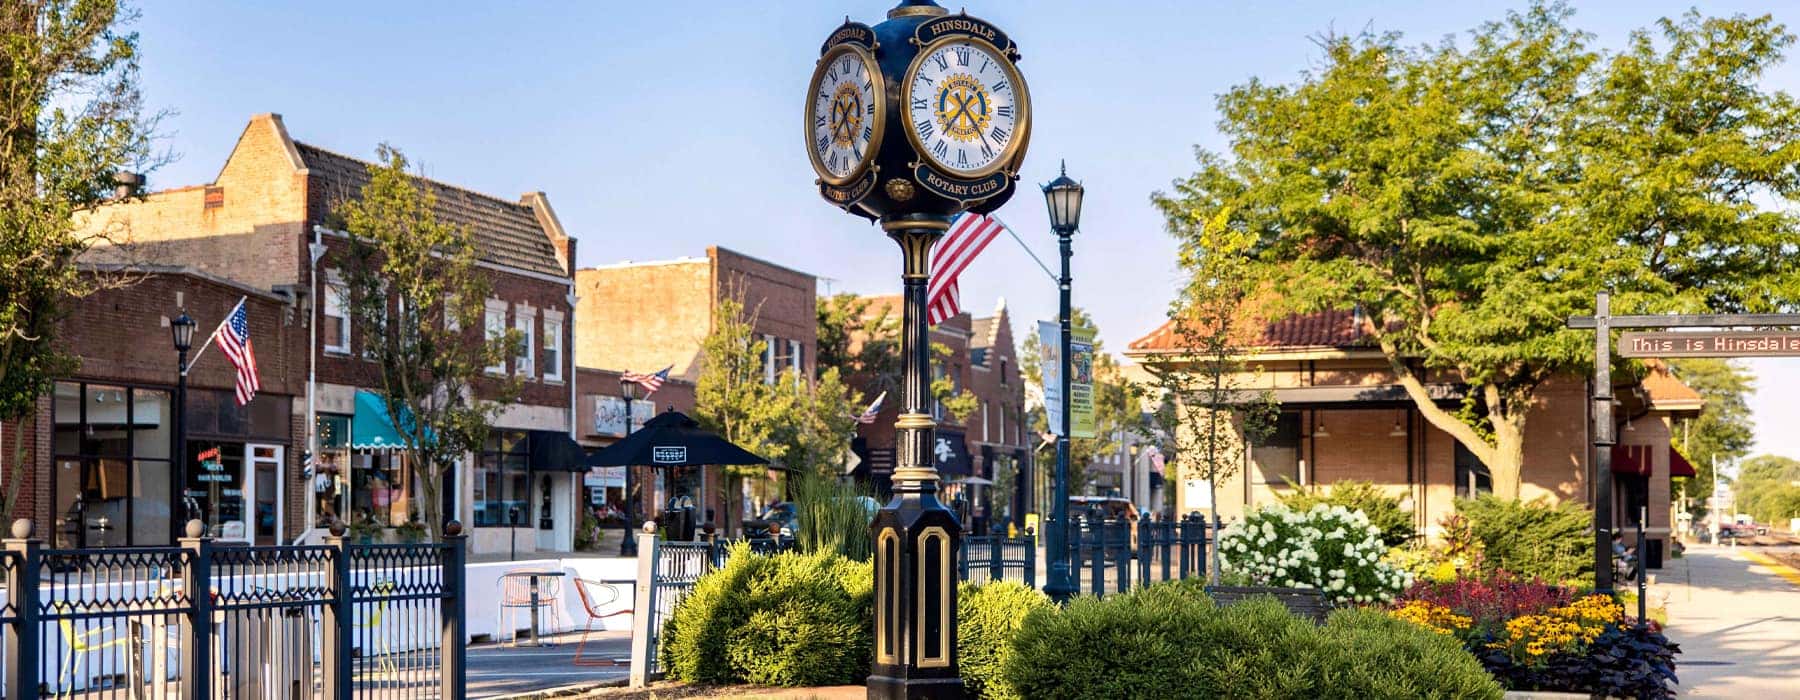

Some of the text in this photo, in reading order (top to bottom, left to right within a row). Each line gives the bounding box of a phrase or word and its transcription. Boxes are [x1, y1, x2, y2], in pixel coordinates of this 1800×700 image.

[931, 20, 996, 41] HINSDALE
[828, 28, 866, 49] HINSDALE
[934, 53, 949, 72] XI
[956, 52, 970, 67] XII
[979, 60, 988, 73] I
[920, 74, 933, 86] X
[992, 81, 1005, 92] II
[915, 98, 927, 109] IX
[998, 106, 1010, 117] III
[934, 139, 948, 158] VII
[958, 149, 967, 164] VI
[927, 174, 998, 195] ROTARY CLUB
[826, 184, 851, 202] ROTARY
[1632, 336, 1800, 352] This is Hinsdale
